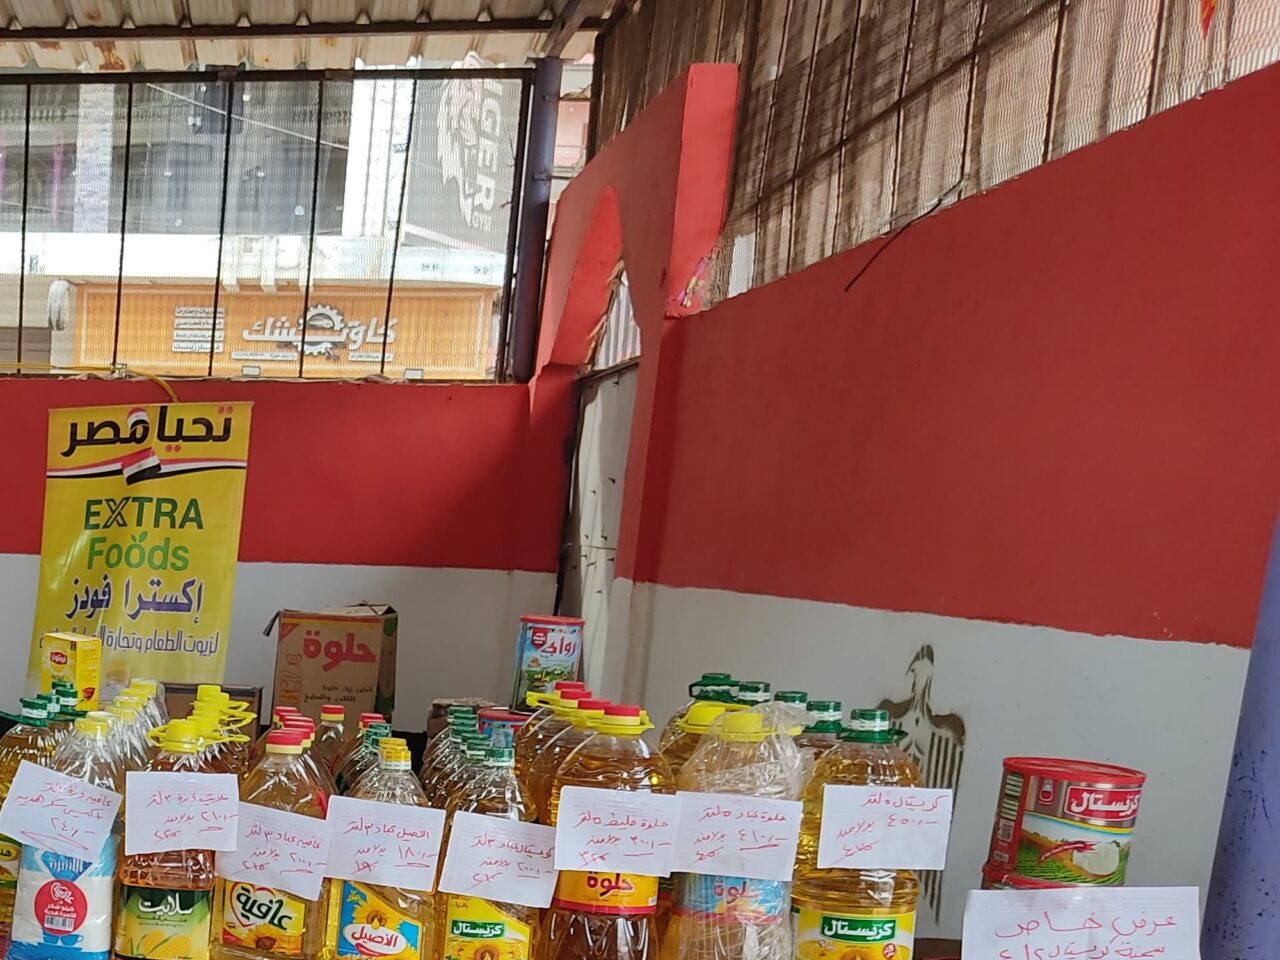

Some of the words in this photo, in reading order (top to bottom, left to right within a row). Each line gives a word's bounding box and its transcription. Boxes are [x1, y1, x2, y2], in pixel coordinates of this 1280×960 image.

[156, 405, 233, 453] تحيا
[84, 496, 204, 530] EXTRA
[87, 531, 190, 571] Foods
[65, 574, 112, 620] فودز
[124, 578, 204, 624] إكسترا
[302, 629, 377, 672] حلوة
[1070, 792, 1140, 814] كريستال
[236, 886, 293, 931] عافية
[452, 922, 504, 936] كريستال
[824, 920, 894, 939] كريستال
